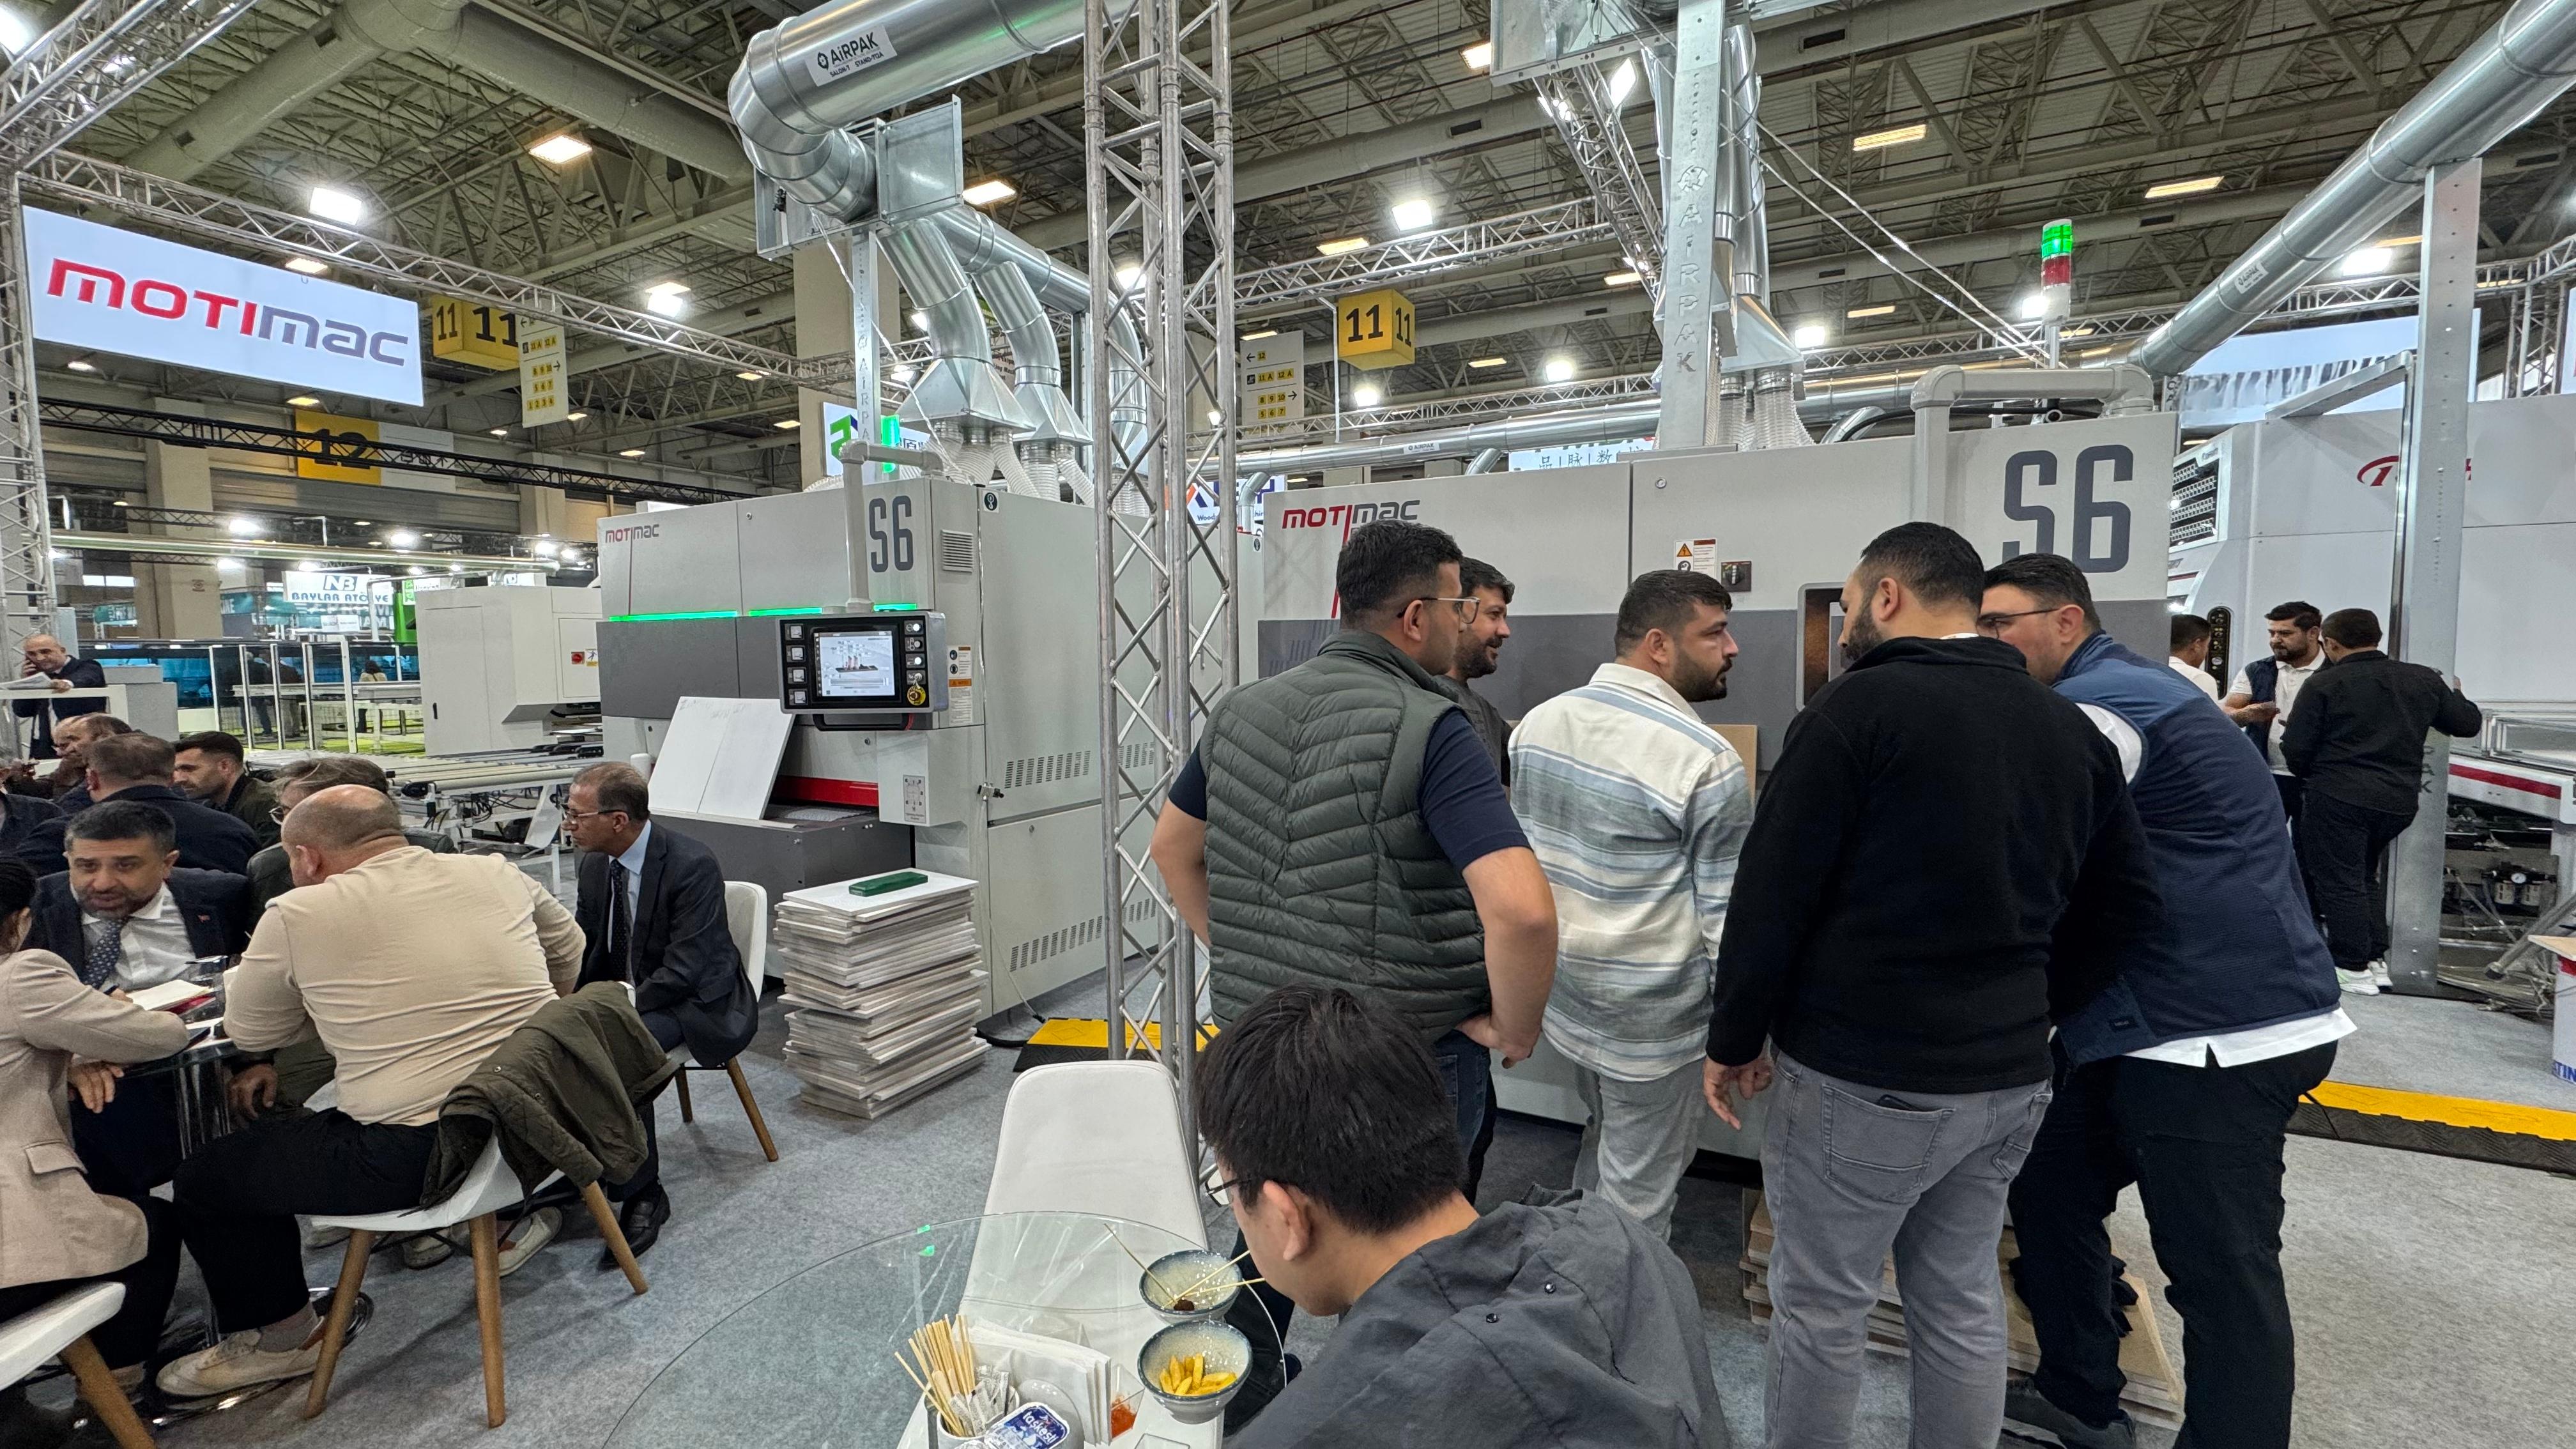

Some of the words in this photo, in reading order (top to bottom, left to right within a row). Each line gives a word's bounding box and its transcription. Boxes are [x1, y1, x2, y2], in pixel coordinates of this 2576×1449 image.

[436, 302, 458, 341] 11
[473, 306, 519, 348] 11
[1346, 304, 1384, 342] 11
[1395, 307, 1412, 348] 11
[312, 429, 371, 470] 12
[2002, 444, 2134, 573] S6
[869, 495, 914, 573] S6
[291, 592, 340, 602] BAYLAR
[345, 591, 389, 602] ATÖYE
